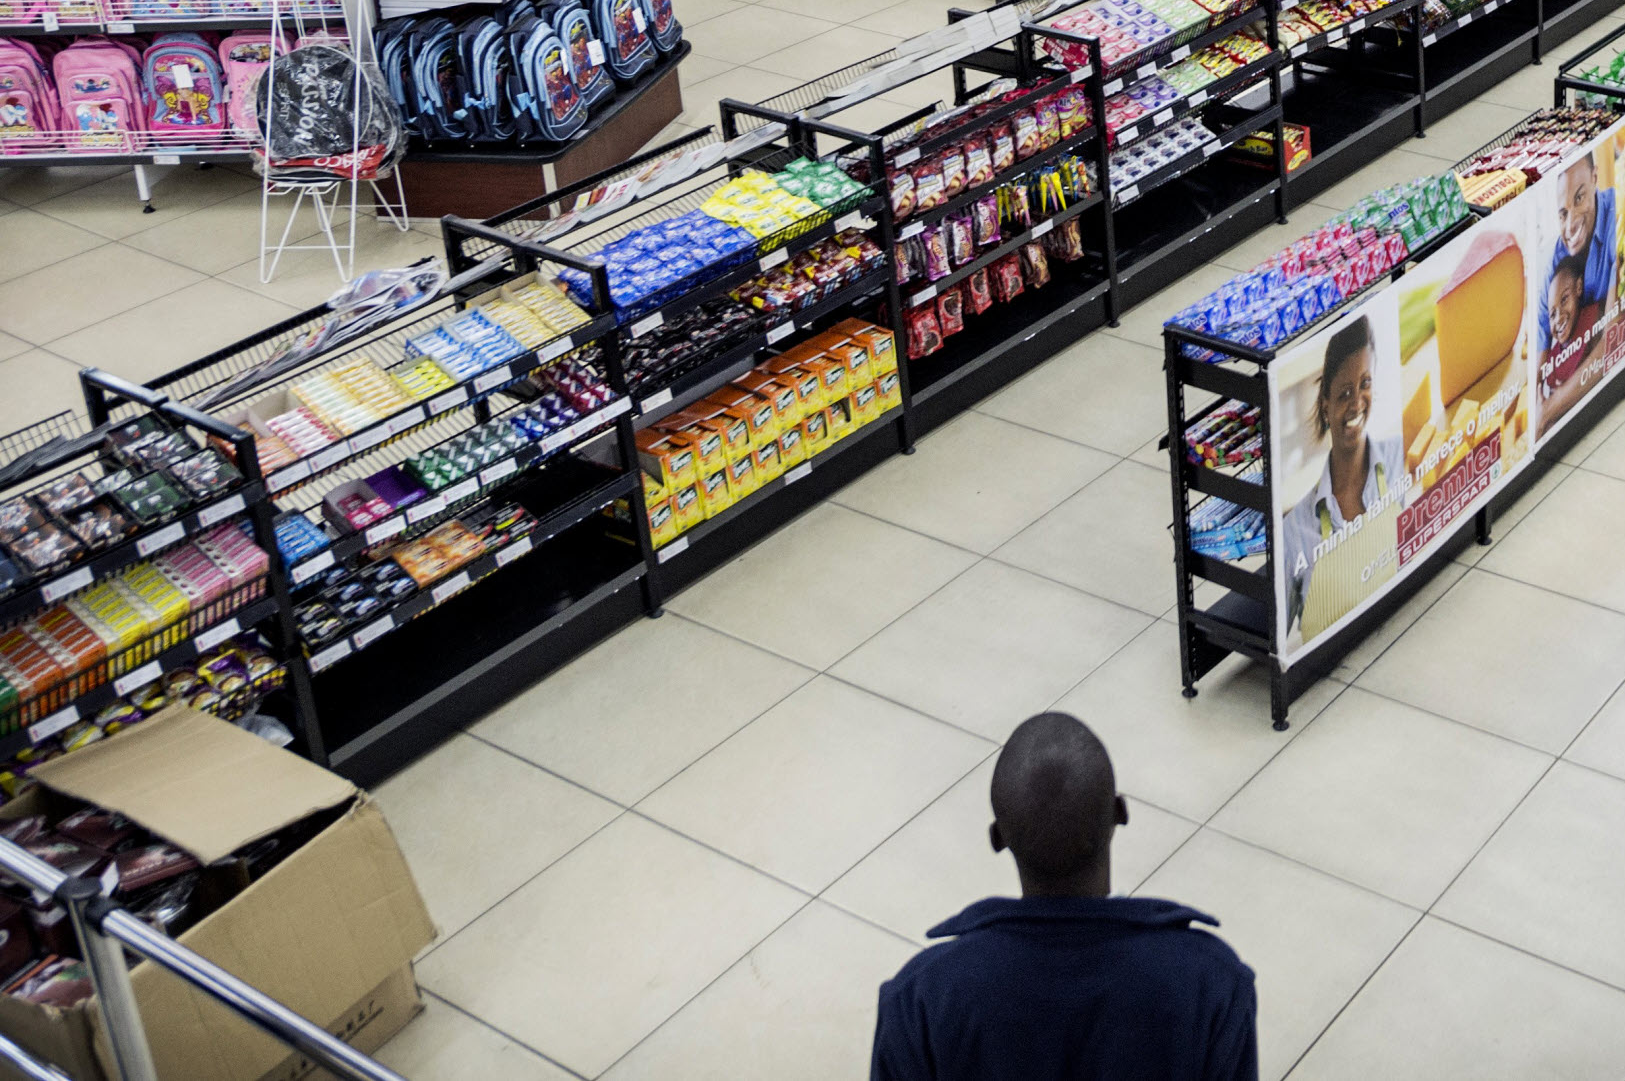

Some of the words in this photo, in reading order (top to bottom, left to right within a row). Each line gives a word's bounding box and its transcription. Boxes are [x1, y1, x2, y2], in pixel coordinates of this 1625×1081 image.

[1540, 356, 1554, 380] Tal
[1555, 336, 1582, 368] como
[1584, 329, 1590, 342] a
[1592, 303, 1619, 336] mamã
[1294, 550, 1308, 577] A
[1313, 510, 1363, 562] minha
[1366, 473, 1414, 522] família
[1415, 429, 1464, 481] merece
[1466, 420, 1476, 436] o
[1478, 383, 1522, 426] melhor.
[1397, 432, 1501, 544] Premier
[1402, 475, 1489, 562] SUPERSPAR
